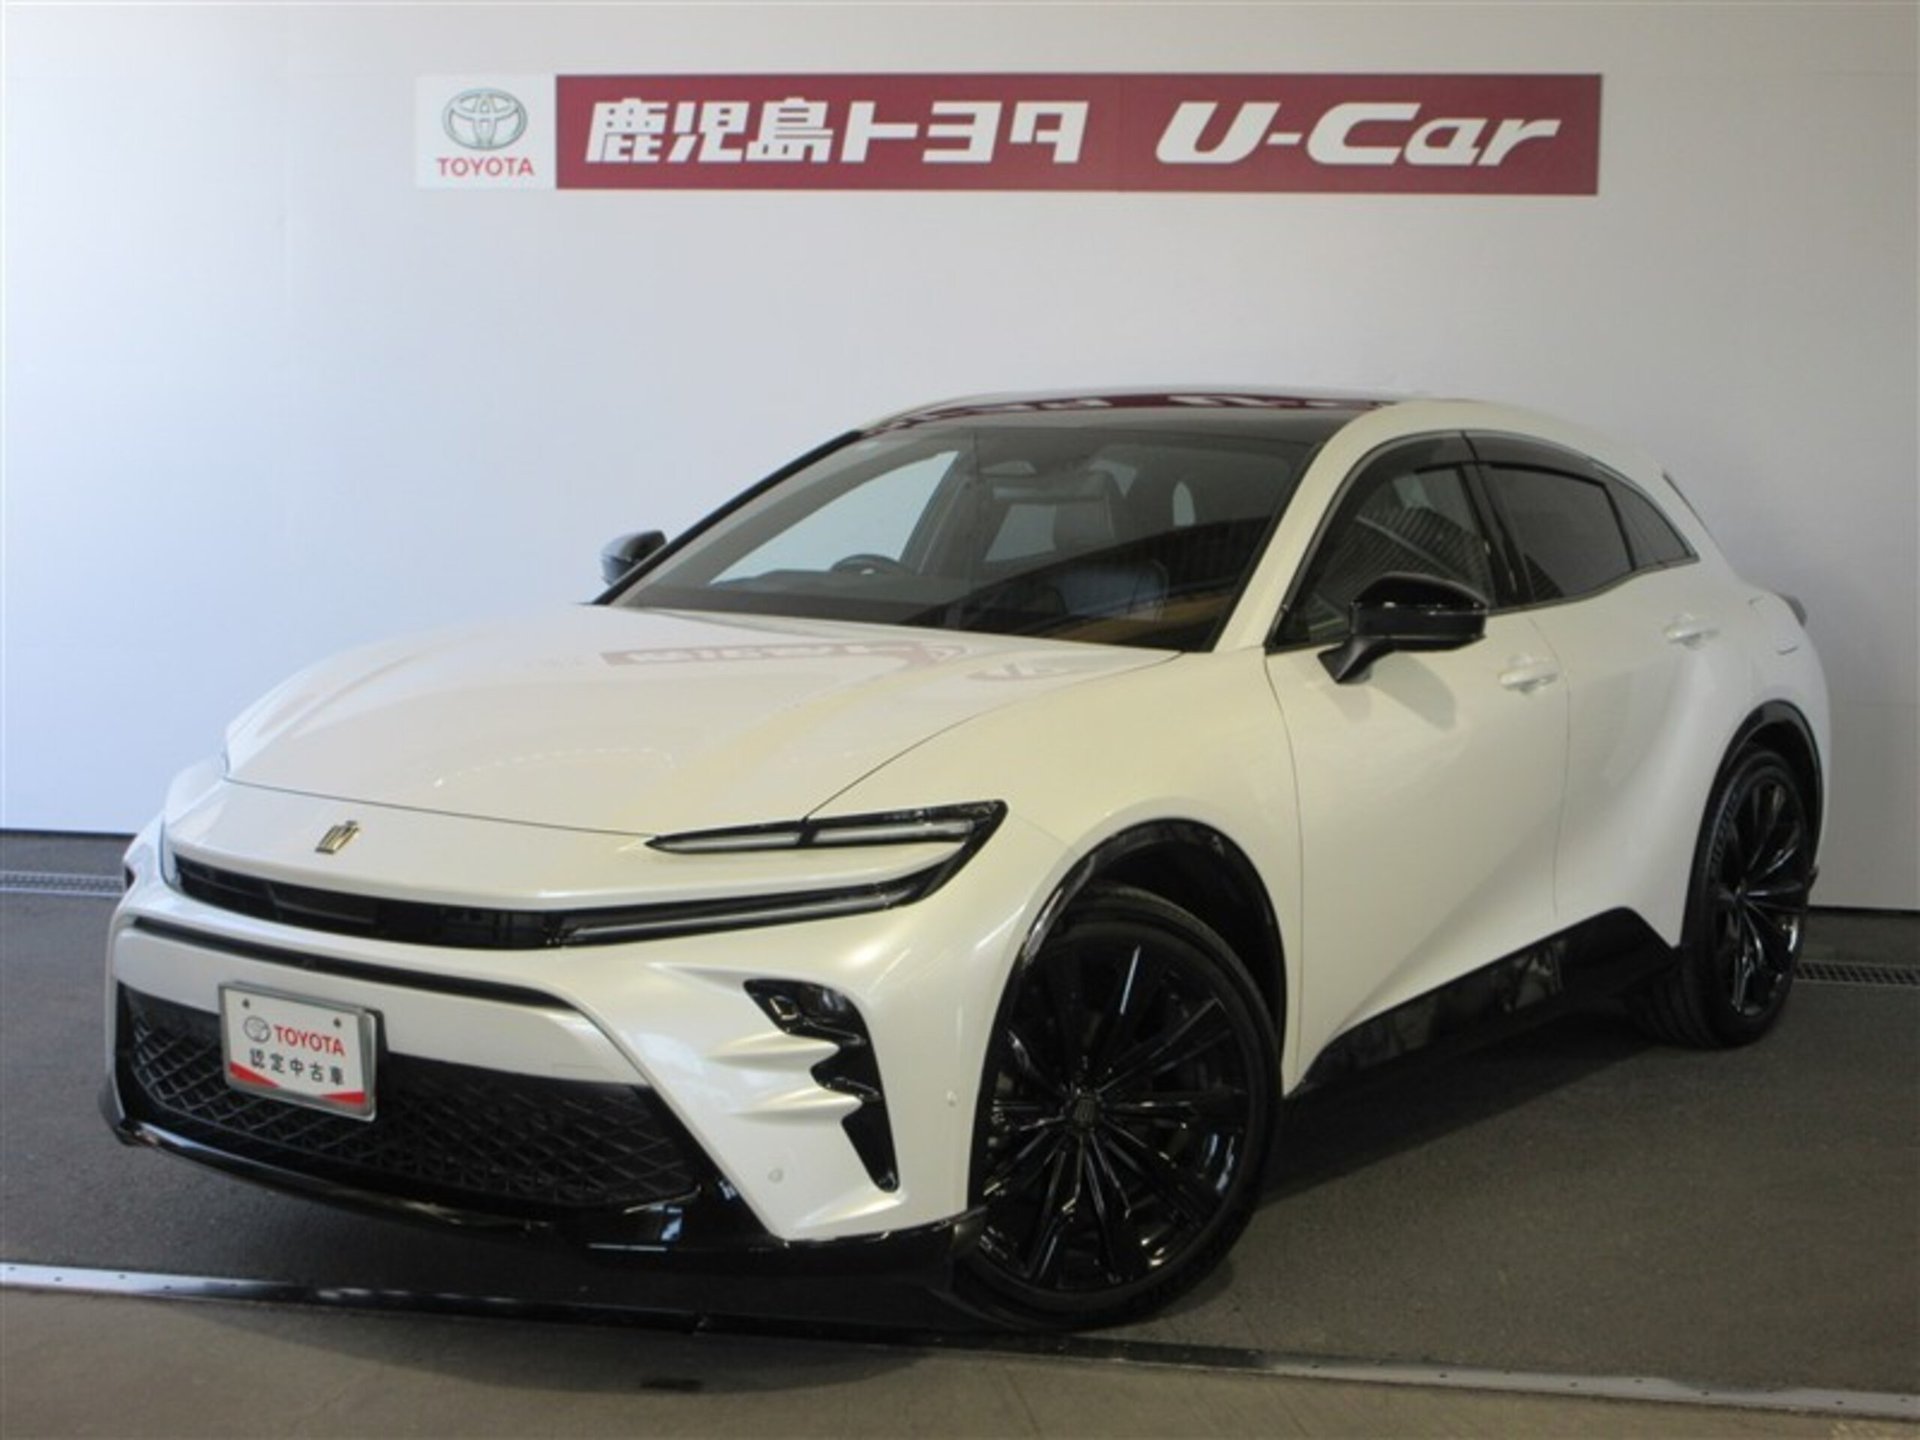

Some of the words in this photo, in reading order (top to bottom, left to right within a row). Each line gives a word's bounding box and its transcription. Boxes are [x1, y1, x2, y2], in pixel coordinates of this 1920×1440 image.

[585, 97, 1089, 163] 鹿児島トヨタ
[1155, 101, 1561, 166] U-Car
[436, 157, 535, 177] TOYOTA
[273, 1024, 345, 1056] TOYOTA
[250, 1048, 344, 1085] 認定中古車
